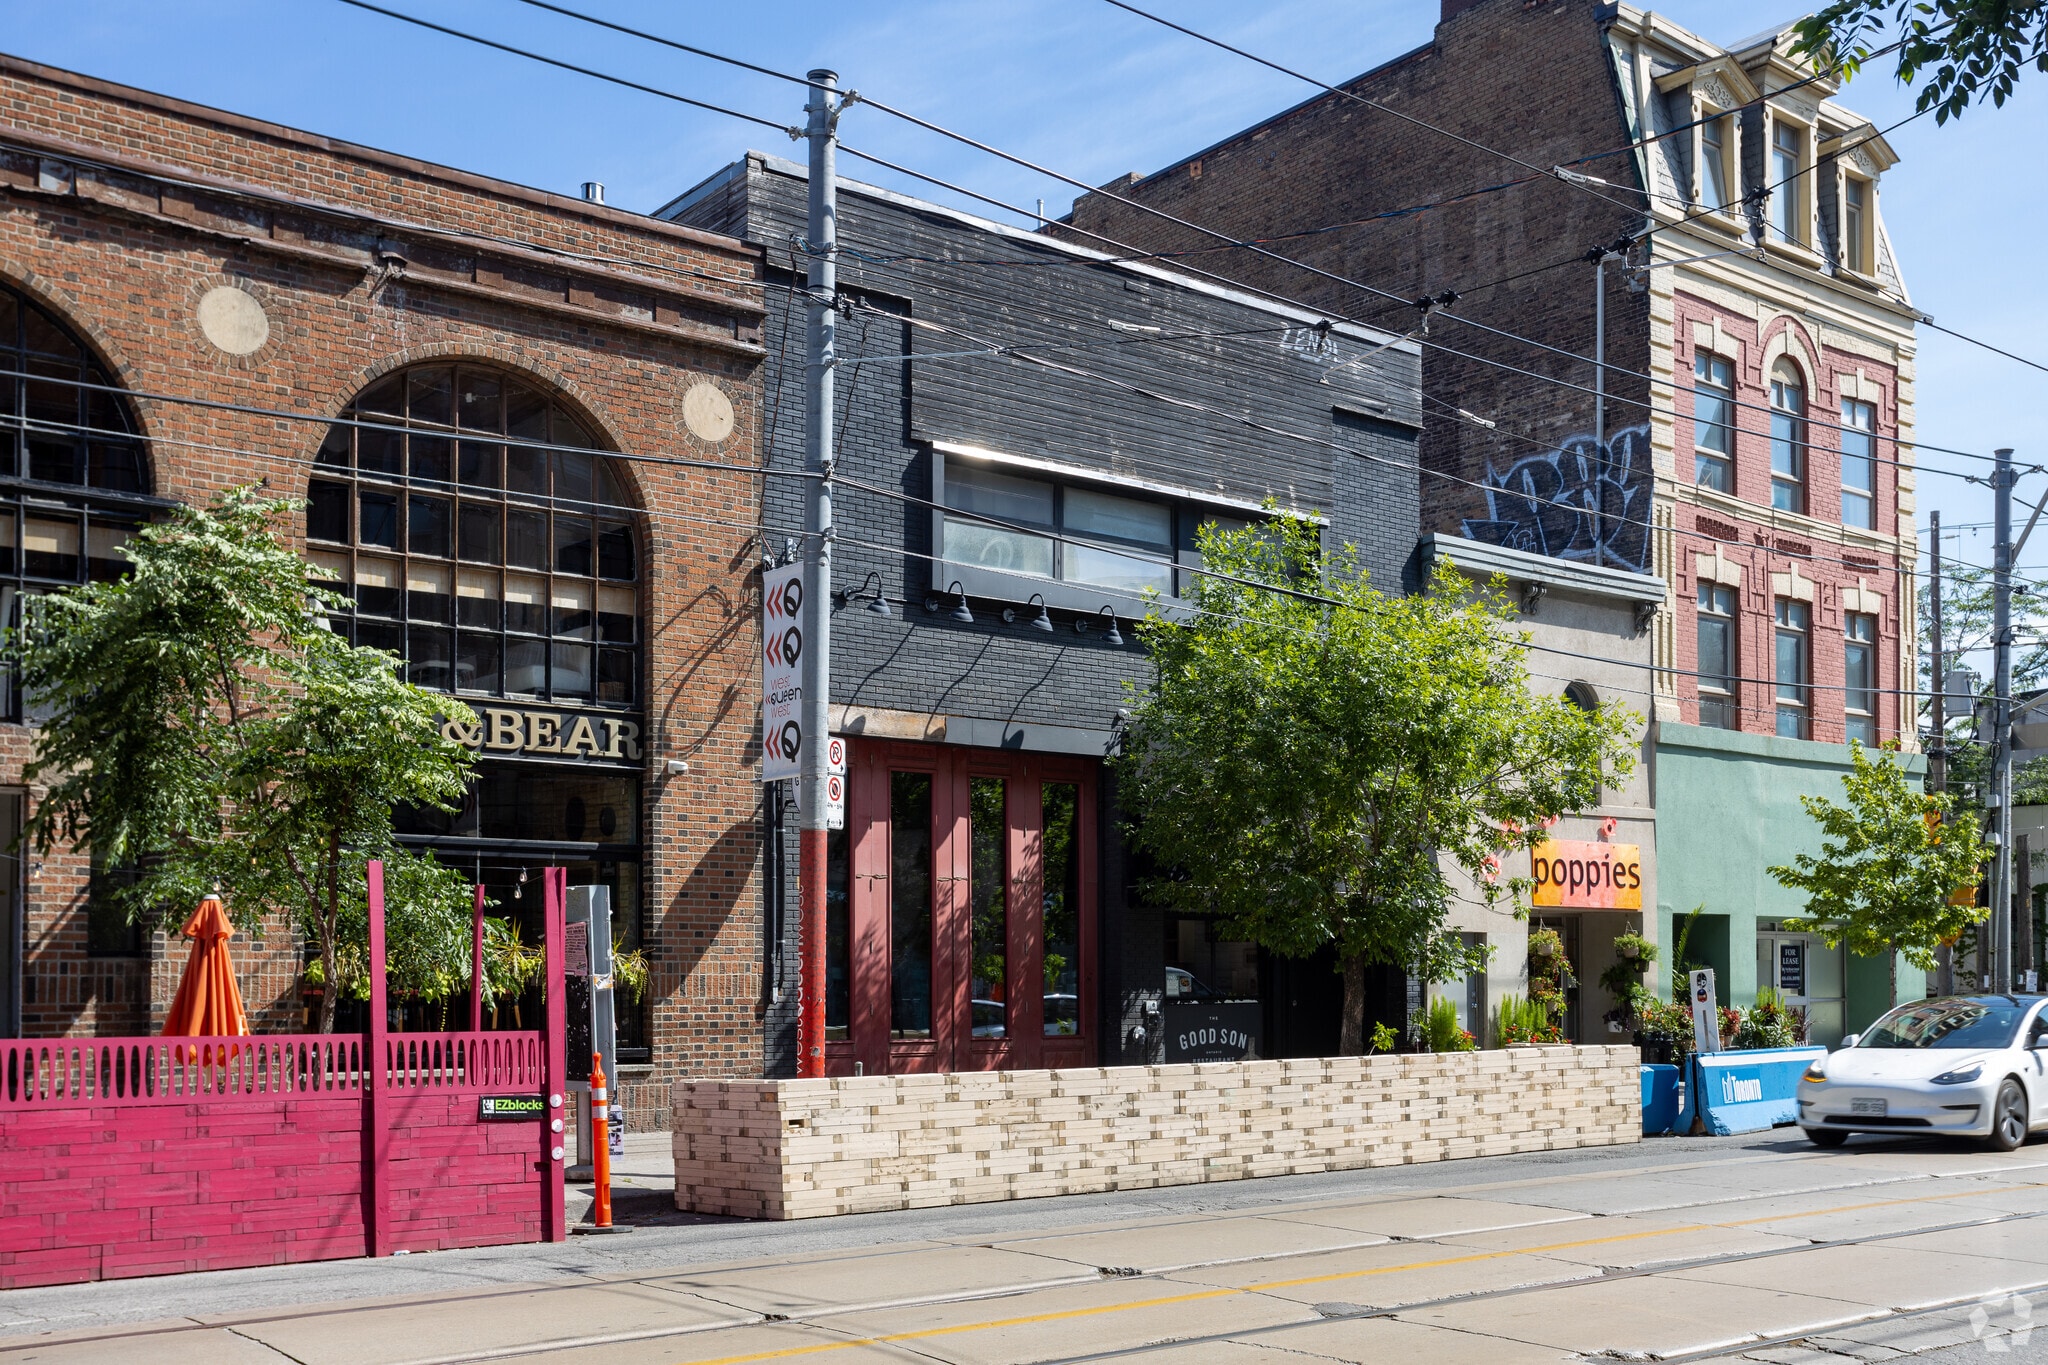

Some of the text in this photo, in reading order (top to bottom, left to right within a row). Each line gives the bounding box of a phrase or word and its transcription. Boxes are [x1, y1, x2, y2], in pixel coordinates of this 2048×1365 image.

[784, 577, 803, 620] Q
[783, 626, 802, 668] Q
[770, 703, 791, 719] west
[781, 720, 802, 763] Q
[1534, 853, 1640, 897] poppies
[1782, 957, 1800, 965] LEASE
[1784, 948, 1797, 956] FOR
[1179, 1028, 1247, 1050] GOOD SON
[495, 1099, 544, 1110] EZblocks
